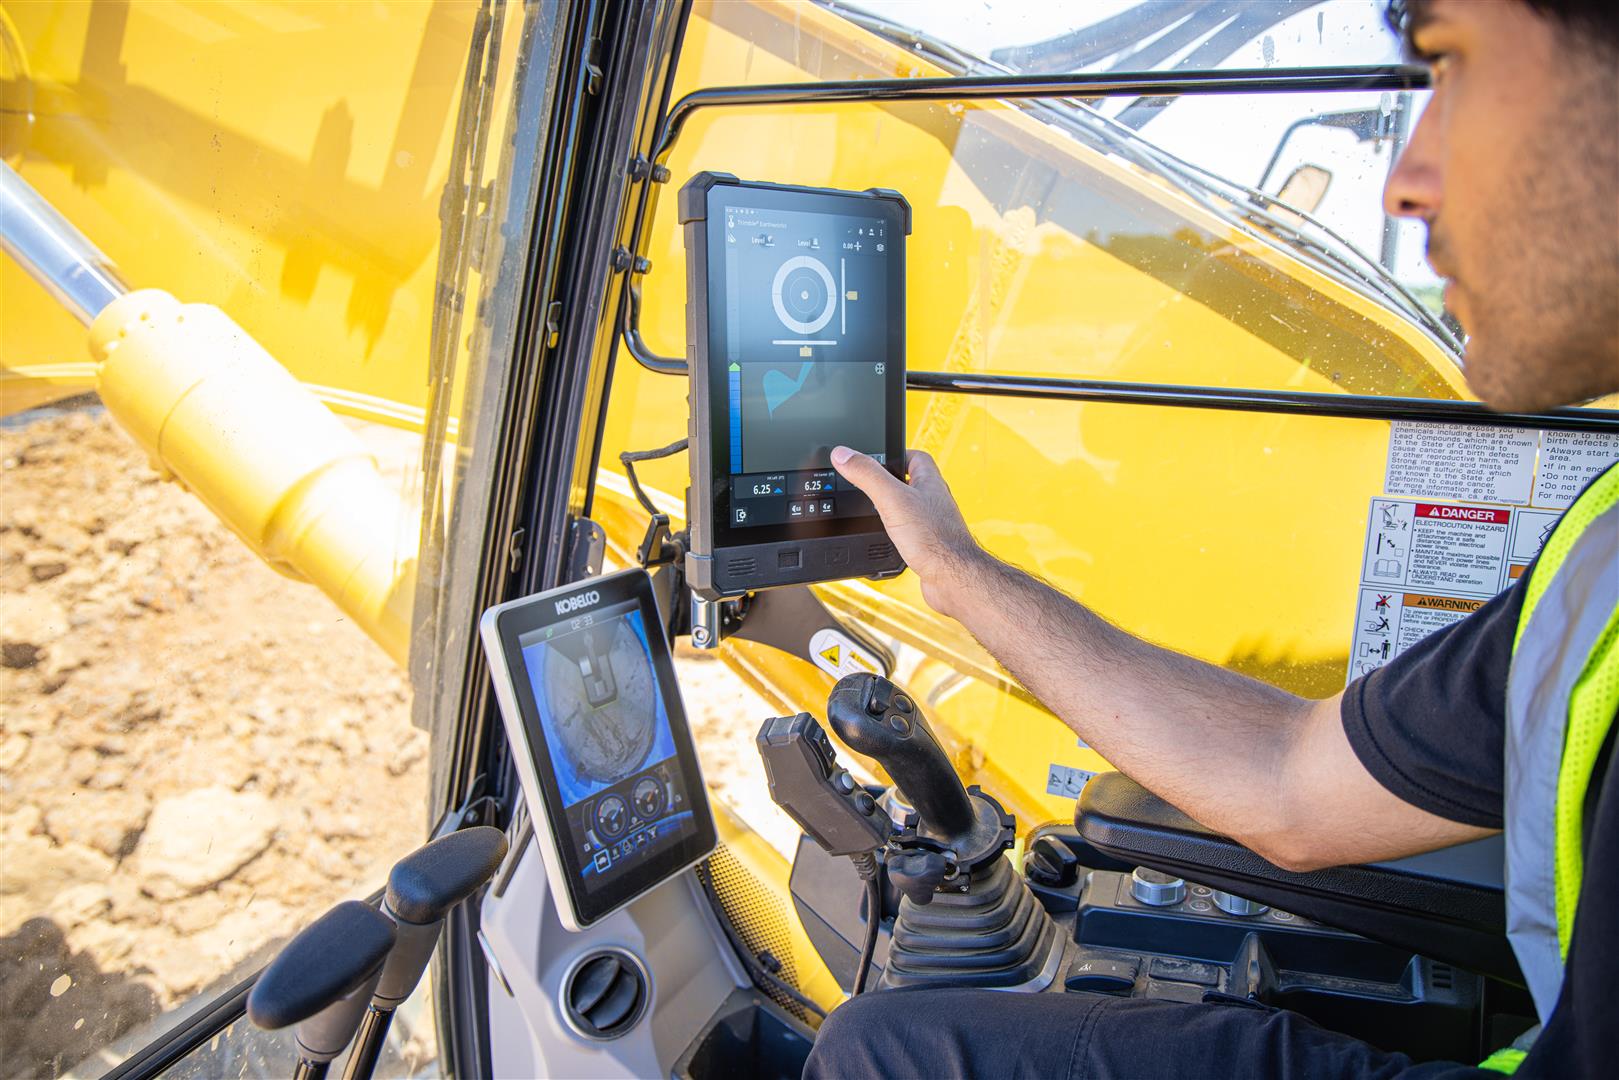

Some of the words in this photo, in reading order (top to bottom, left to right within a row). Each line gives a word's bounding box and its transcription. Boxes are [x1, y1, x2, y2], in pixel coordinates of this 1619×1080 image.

[752, 236, 765, 244] Level
[1390, 464, 1430, 472] containing
[753, 484, 770, 494] 6.25
[804, 481, 821, 491] 6.25
[1426, 484, 1469, 492] information
[1441, 508, 1495, 521] DANGER
[1416, 520, 1473, 530] ELECTROCUTION
[1412, 574, 1453, 582] UNDERSTAND
[555, 590, 600, 615] KOBELCO
[1427, 598, 1480, 611] WARNING
